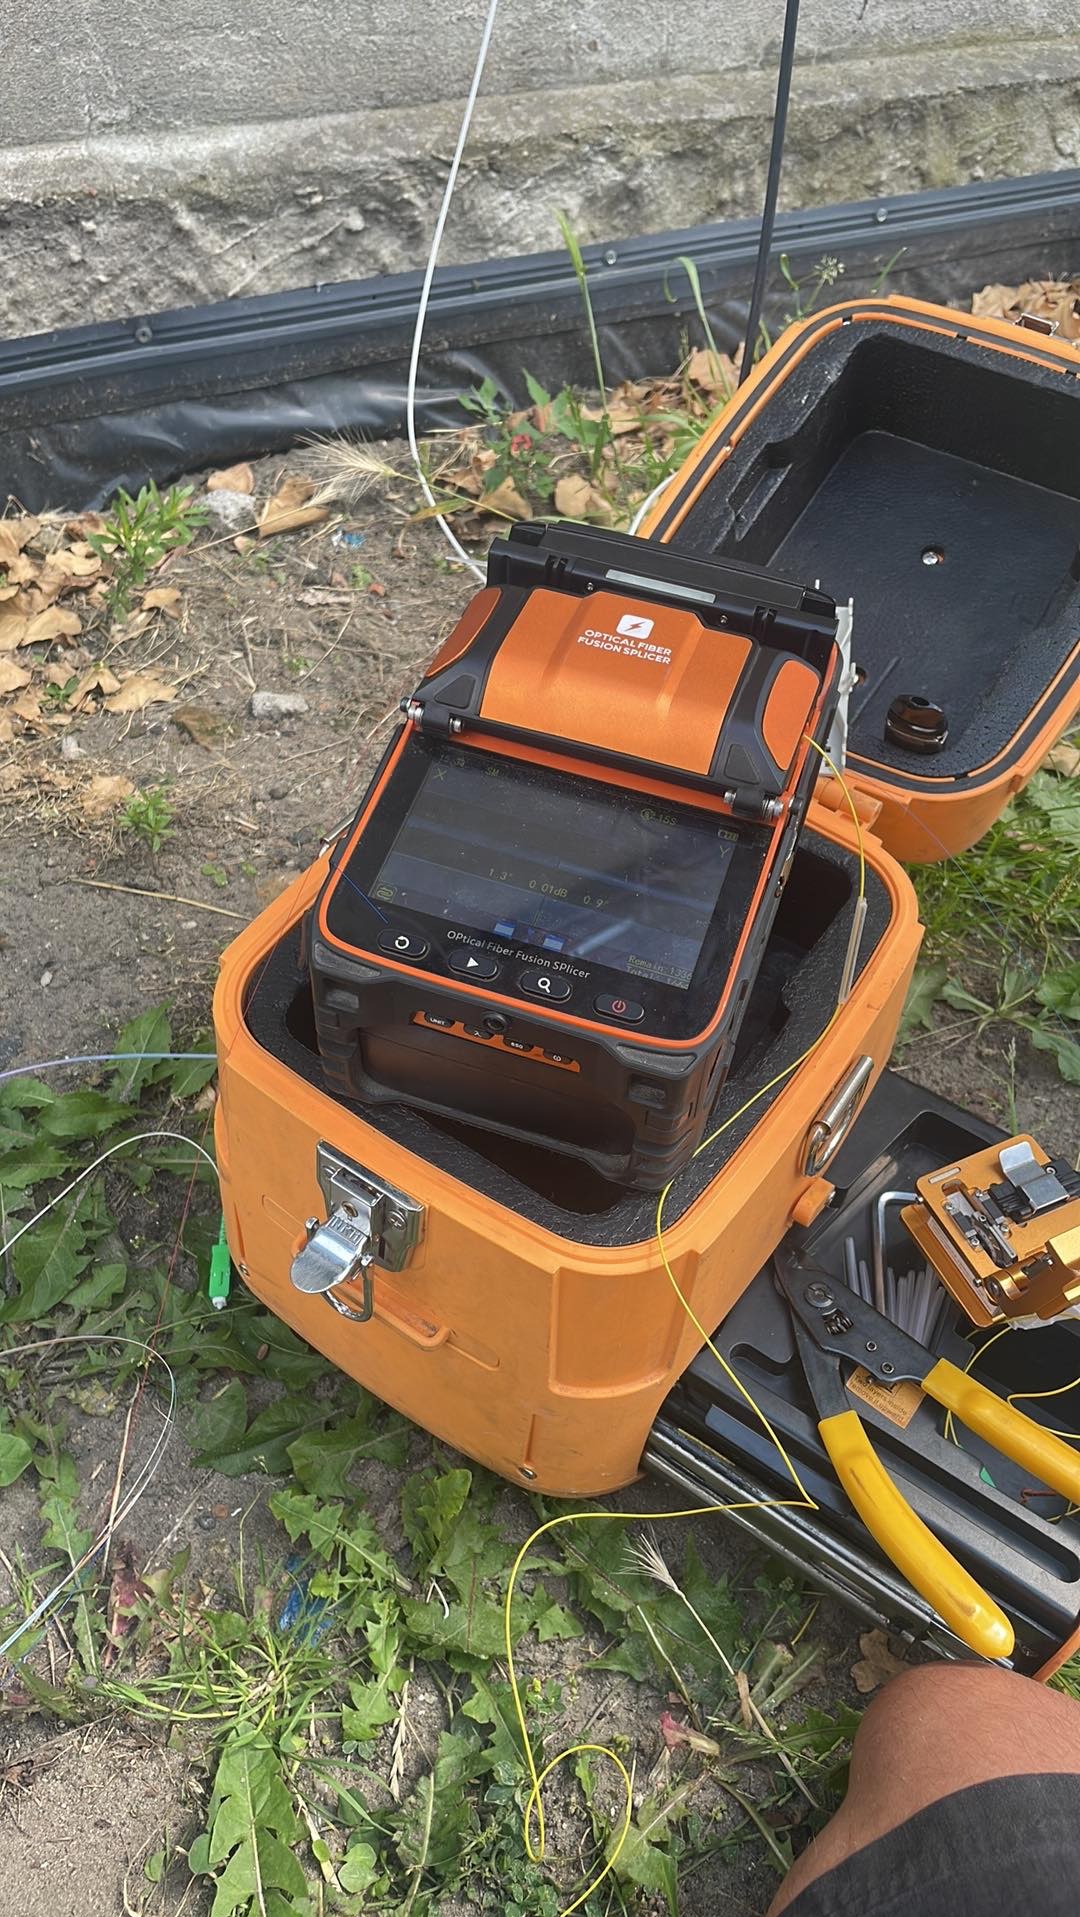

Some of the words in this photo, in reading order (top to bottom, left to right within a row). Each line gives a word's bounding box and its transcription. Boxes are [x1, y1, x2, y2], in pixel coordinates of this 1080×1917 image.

[577, 636, 622, 653] FUSION
[623, 647, 671, 665] SPLICER
[584, 629, 636, 648] OPTICAL
[637, 641, 672, 656] FIBER
[719, 845, 731, 858] Y
[486, 942, 514, 957] Fiber
[515, 950, 551, 968] Fusion
[429, 1017, 446, 1026] UNIT
